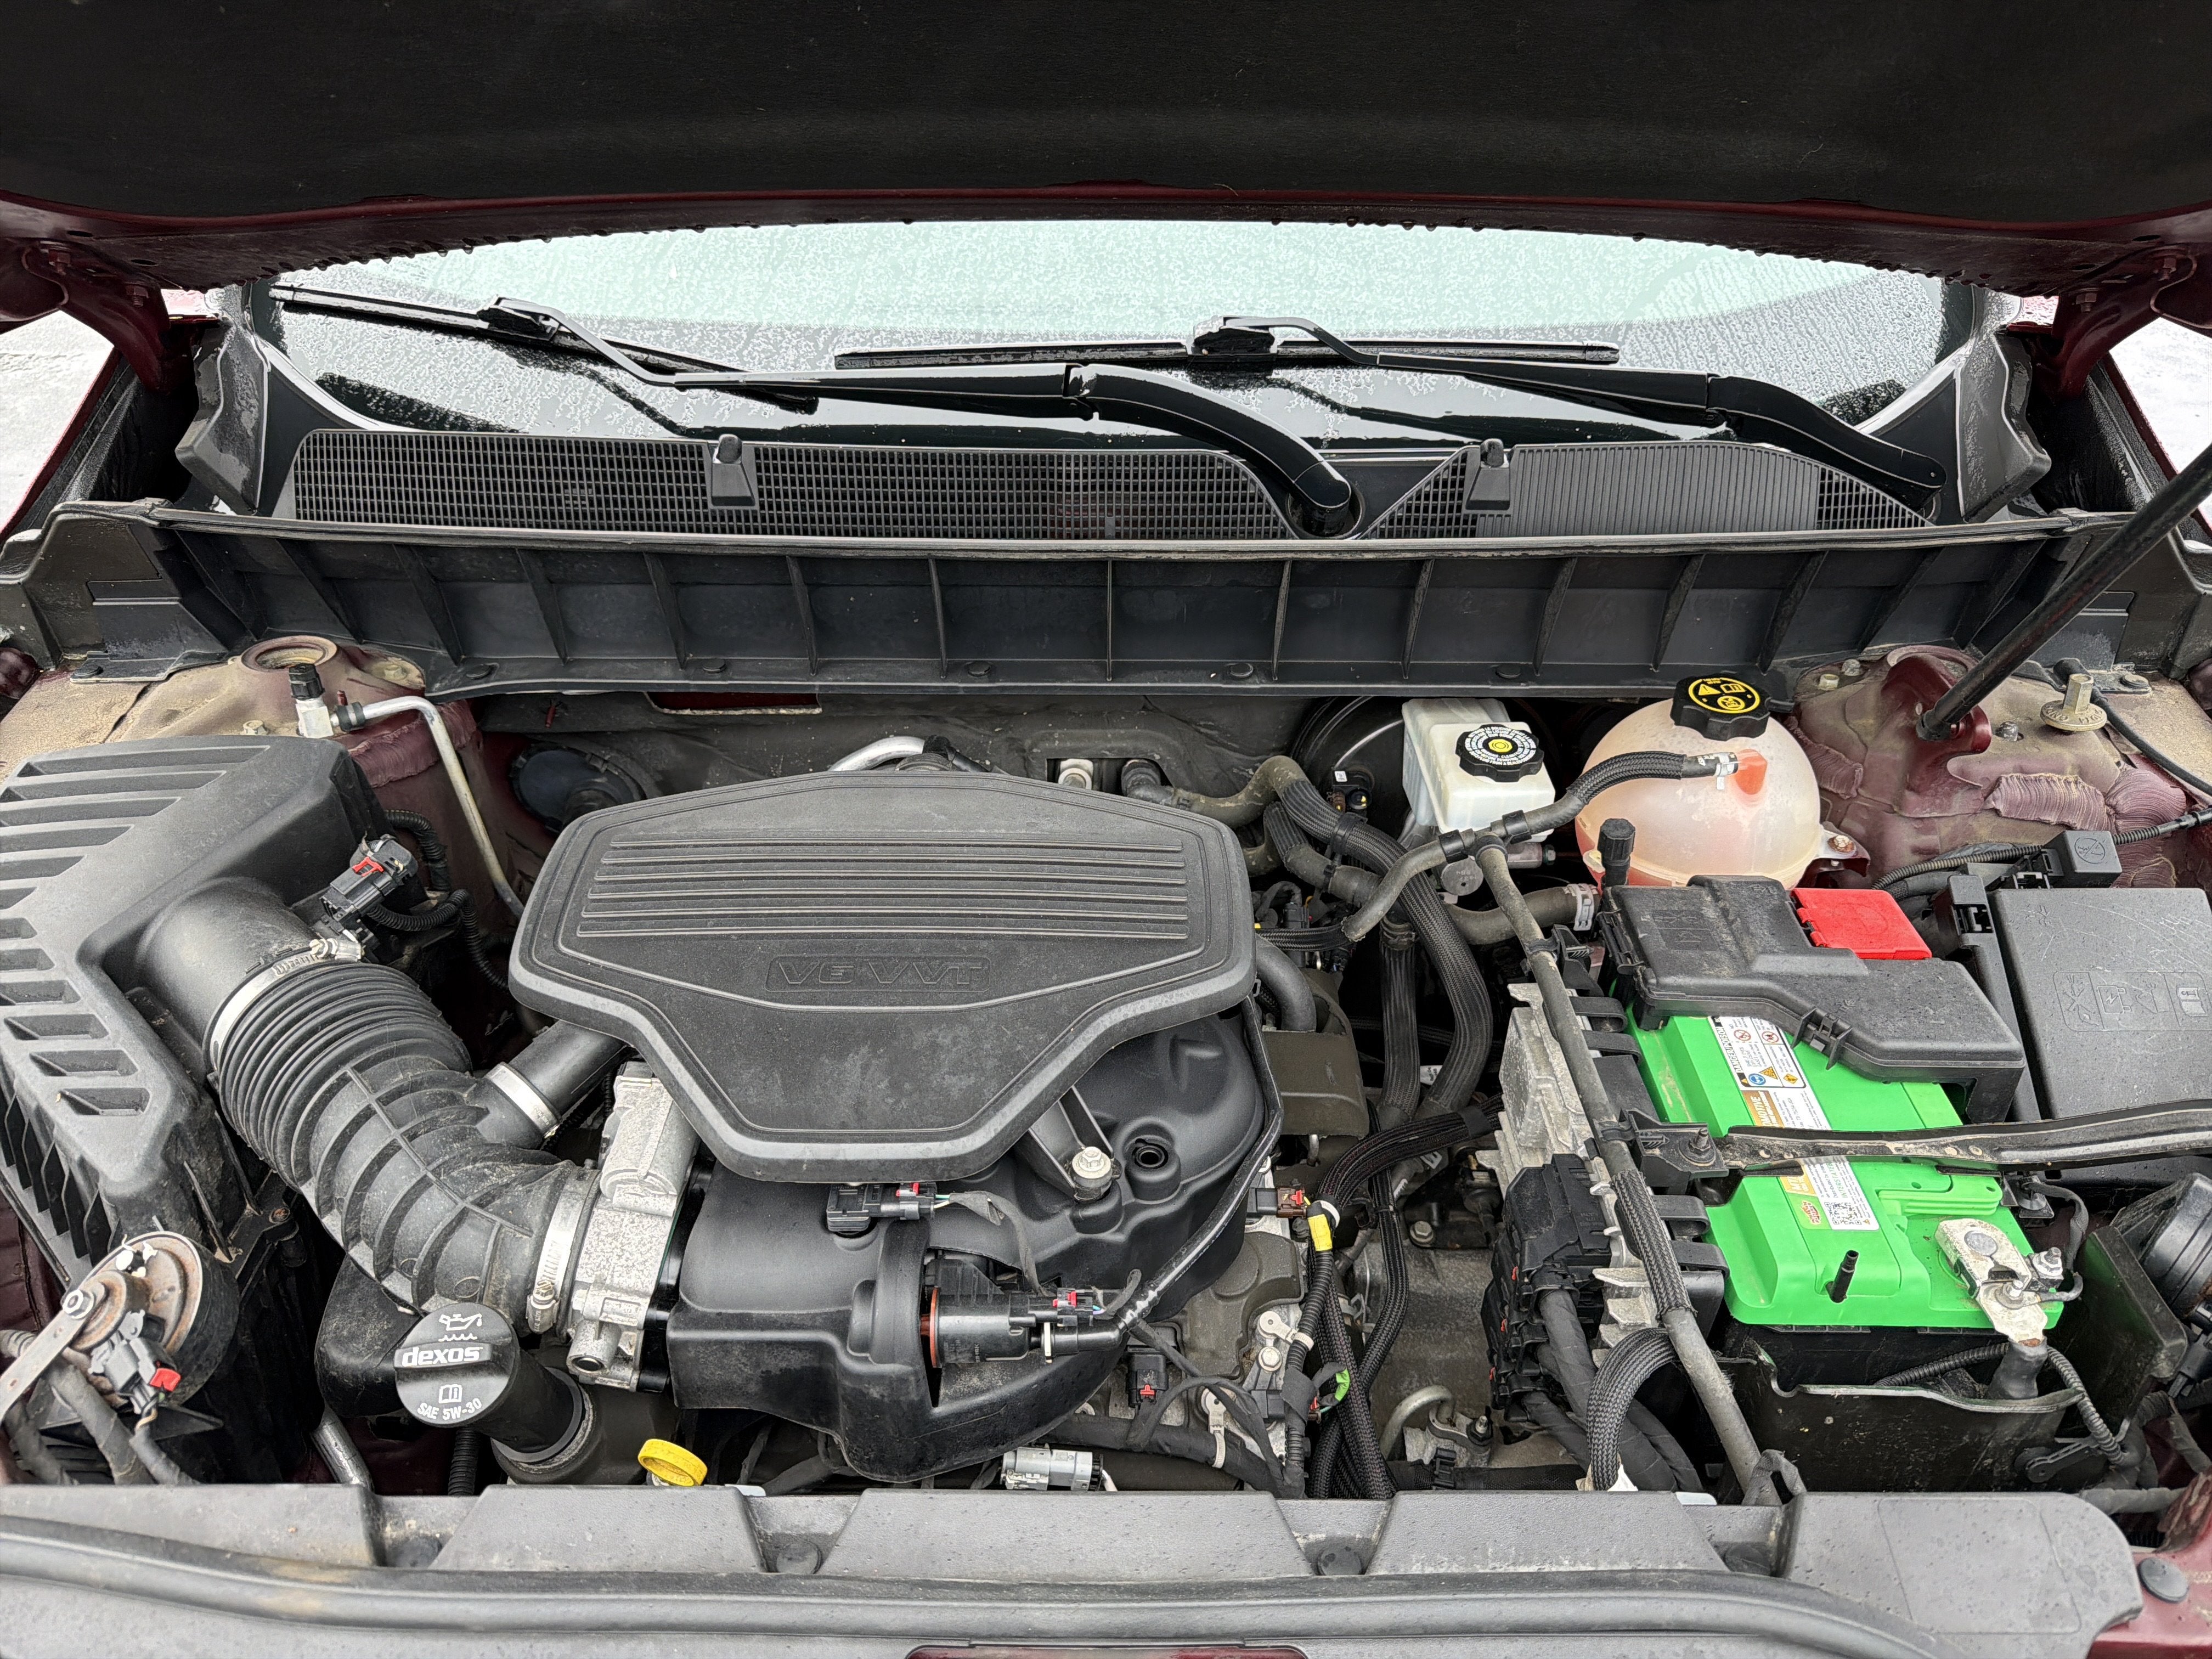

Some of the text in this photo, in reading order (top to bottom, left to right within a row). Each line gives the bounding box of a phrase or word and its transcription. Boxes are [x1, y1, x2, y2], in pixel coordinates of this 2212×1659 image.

[778, 961, 989, 985] V6 VVT
[1716, 1026, 1743, 1073] DANGER/POISON
[1750, 1096, 1771, 1127] OMOTIVE
[402, 1347, 481, 1368] dexos
[417, 1397, 483, 1420] SAE 5W-30
